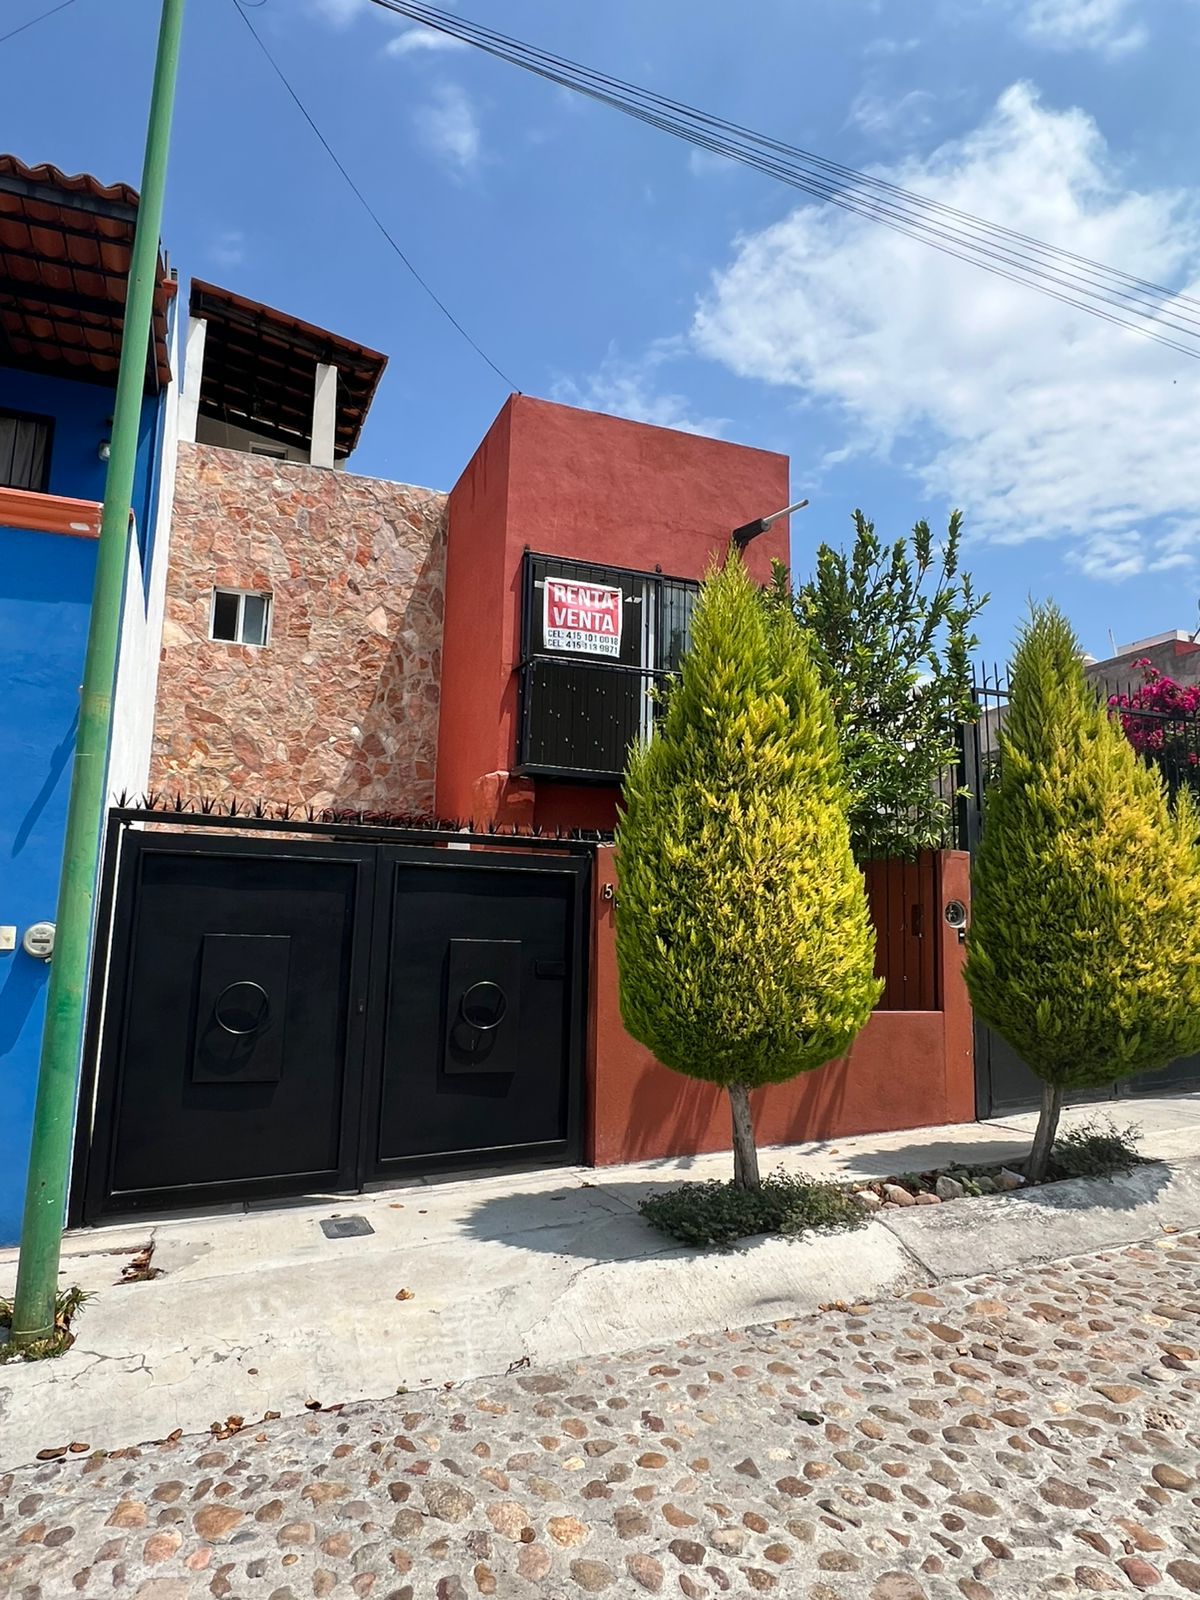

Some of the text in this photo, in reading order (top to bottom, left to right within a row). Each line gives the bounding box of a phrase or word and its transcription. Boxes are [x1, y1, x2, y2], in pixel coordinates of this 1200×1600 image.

[554, 584, 614, 610] RENTA
[553, 607, 614, 633] VENTA
[548, 629, 564, 638] CEL:
[566, 631, 581, 640] 415
[585, 633, 597, 642] 101
[566, 641, 581, 649] 415
